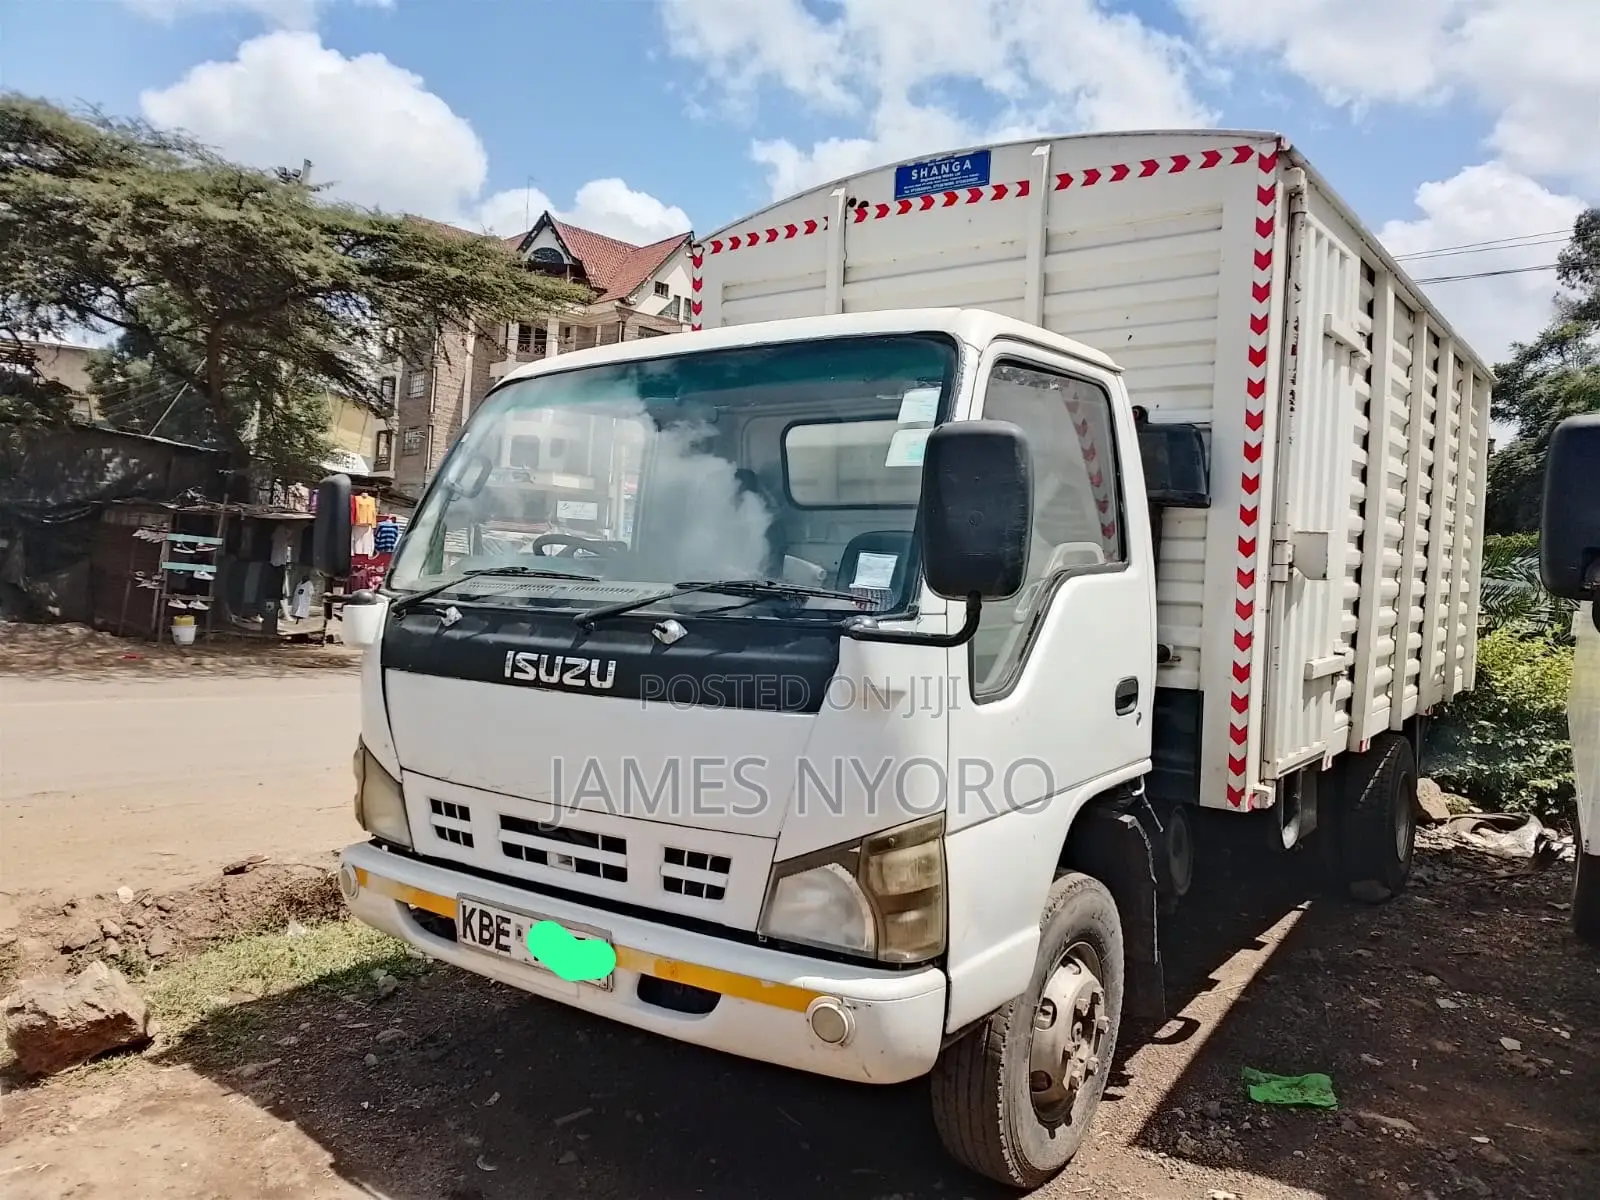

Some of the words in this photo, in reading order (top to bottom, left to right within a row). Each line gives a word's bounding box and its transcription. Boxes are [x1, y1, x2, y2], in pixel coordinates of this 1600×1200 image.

[911, 160, 972, 180] SHANGA
[504, 650, 617, 689] ISUZU
[462, 904, 511, 952] KBE
